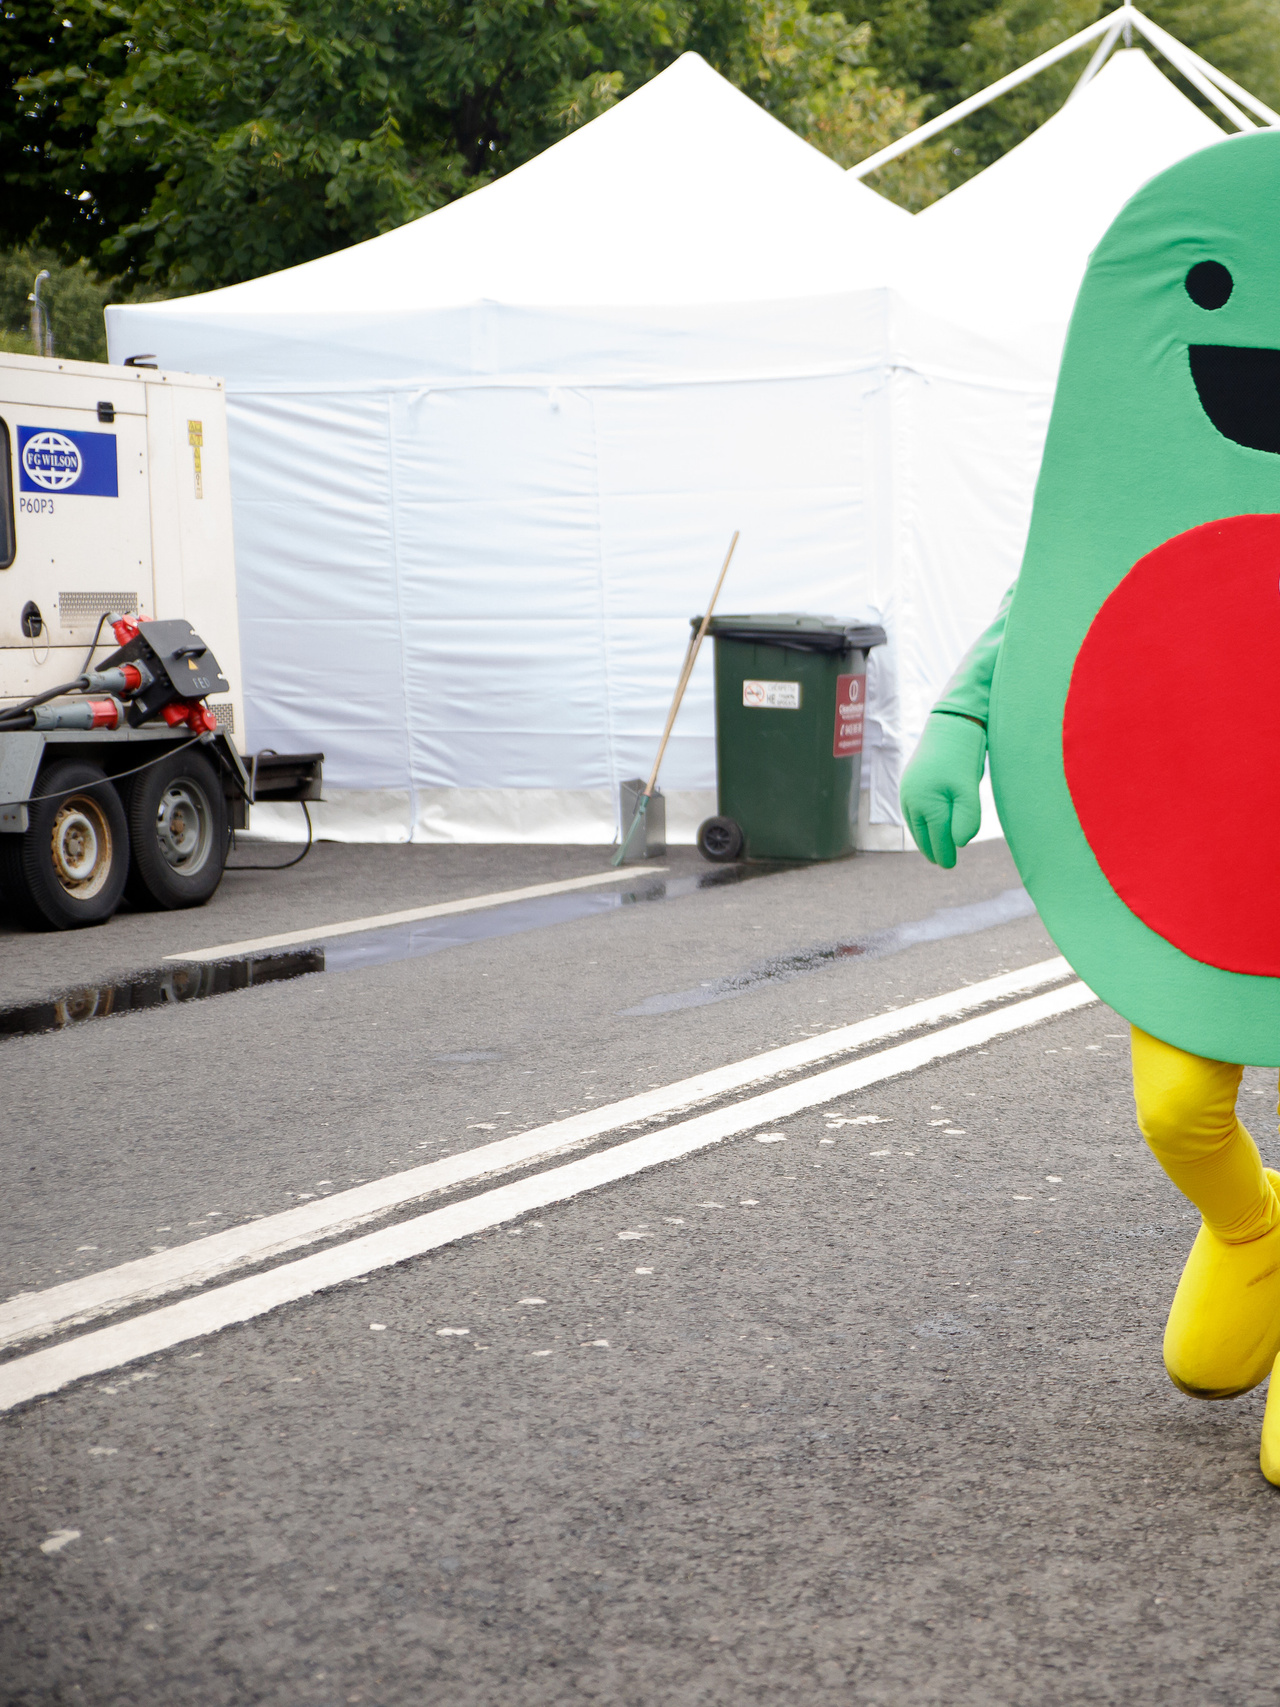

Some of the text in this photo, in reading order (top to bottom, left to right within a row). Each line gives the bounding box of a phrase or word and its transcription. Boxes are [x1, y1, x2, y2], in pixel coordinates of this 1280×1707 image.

[27, 453, 77, 467] FG WILSON
[20, 497, 54, 514] P60P3
